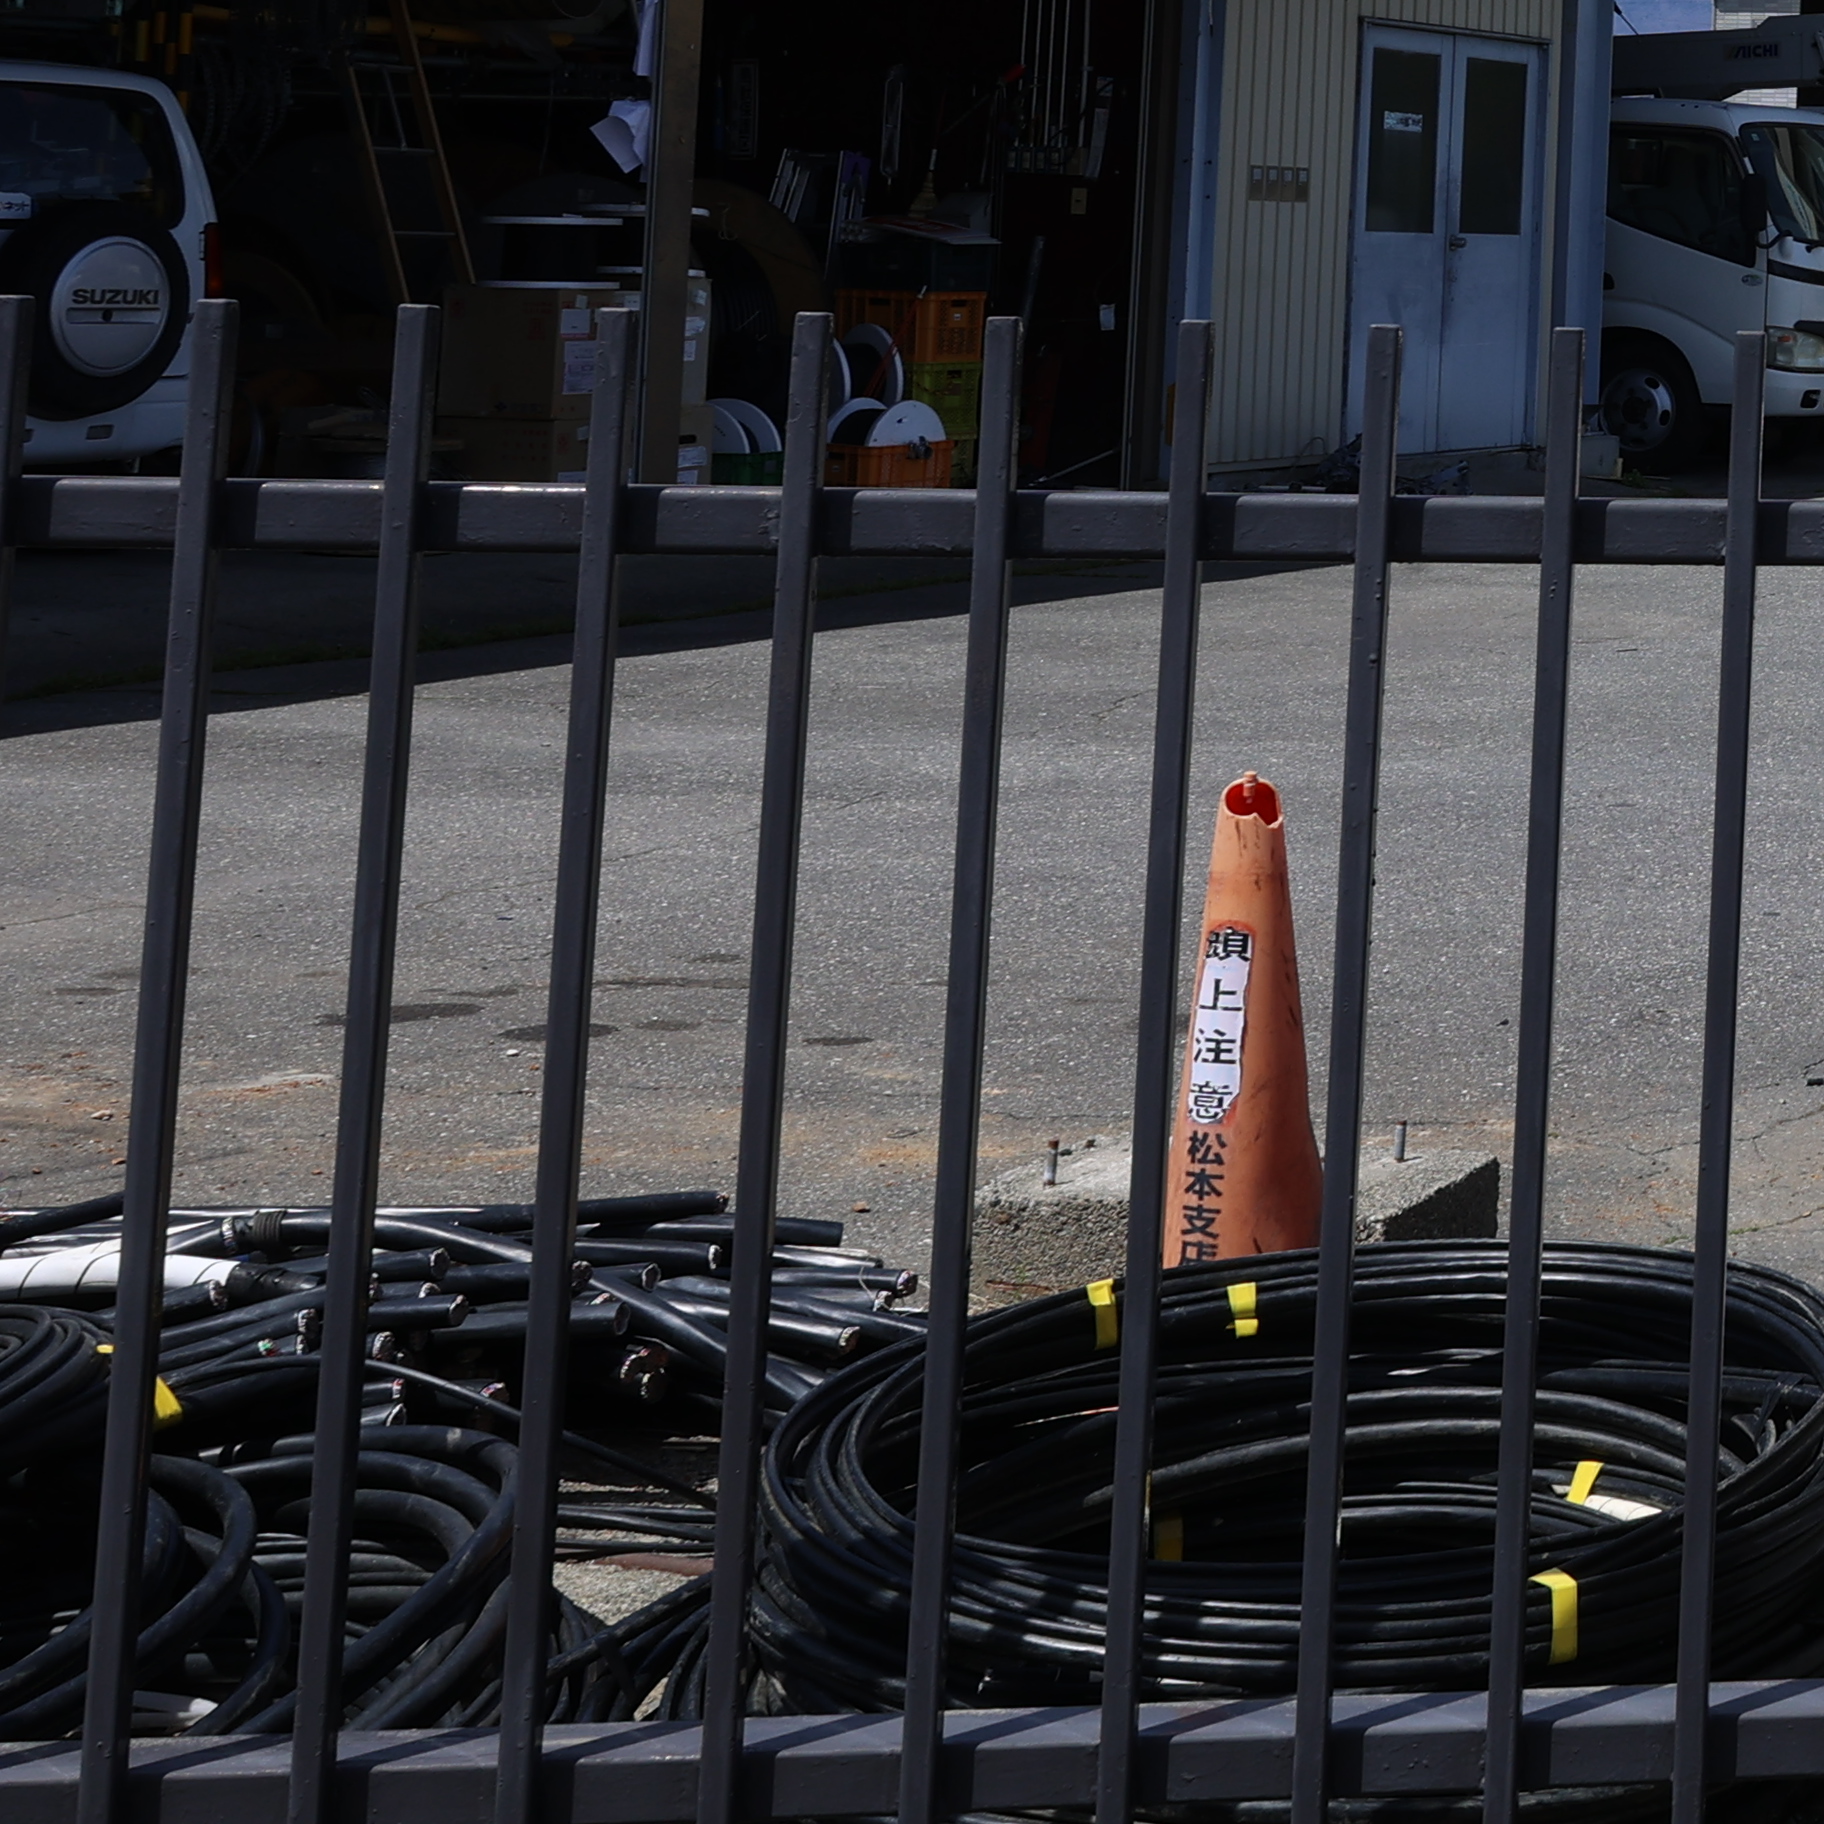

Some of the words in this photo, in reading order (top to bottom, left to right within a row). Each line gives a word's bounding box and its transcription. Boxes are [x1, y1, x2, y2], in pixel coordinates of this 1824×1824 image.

[1733, 43, 1779, 59] AICHI
[71, 288, 160, 306] SUZUKI
[1187, 926, 1252, 1121] 頭上注意
[1177, 1129, 1228, 1266] 松本支店
